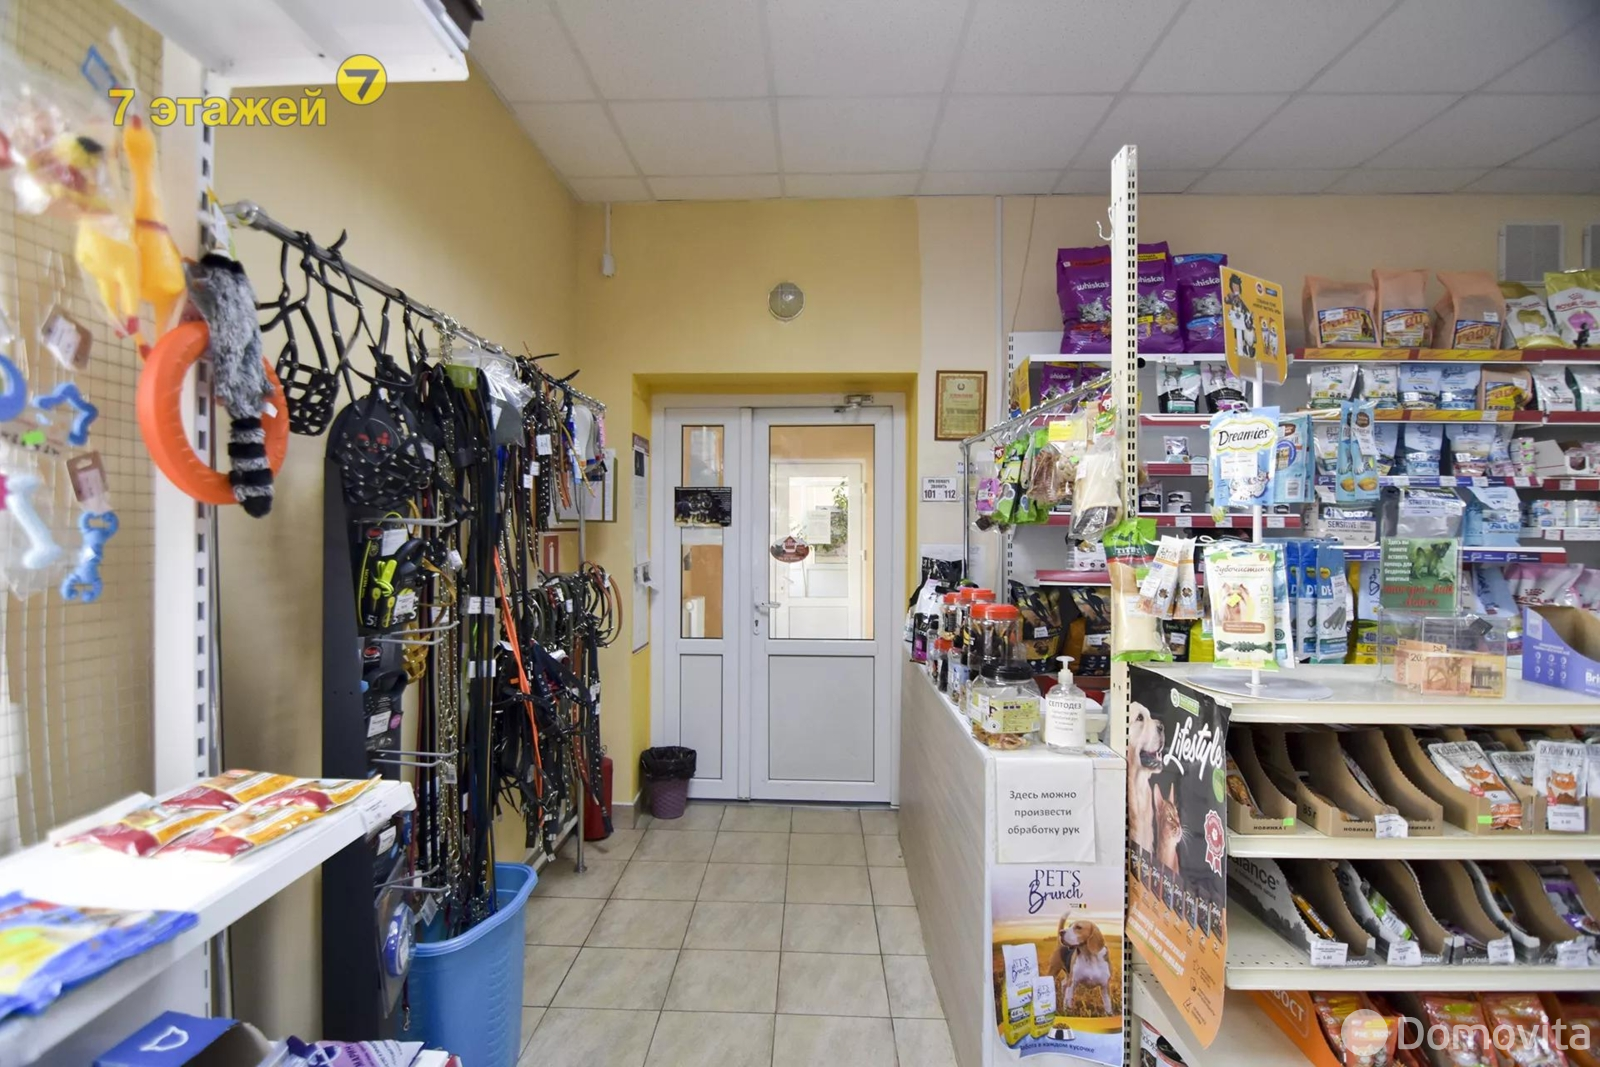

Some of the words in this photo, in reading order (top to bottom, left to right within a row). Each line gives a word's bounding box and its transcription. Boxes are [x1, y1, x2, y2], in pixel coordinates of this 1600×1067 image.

[1077, 281, 1110, 291] whiskas
[1193, 276, 1220, 287] whiska
[1218, 426, 1270, 447] Dreamies
[924, 489, 936, 499] 101
[944, 489, 956, 499] 112
[1327, 520, 1357, 529] SENSITIVE
[1585, 671, 1600, 683] Bri
[1048, 700, 1082, 710] СЕПТОДЕЗ
[1163, 716, 1223, 781] Lifestyle
[1009, 790, 1039, 801] Здесь
[1041, 790, 1077, 800] можно
[1014, 807, 1072, 819] произвести
[1302, 804, 1312, 817] 85
[1007, 824, 1060, 837] обработку
[1062, 826, 1080, 837] рук
[1035, 869, 1081, 887] PET'S
[1028, 879, 1083, 914] Brunch
[1462, 956, 1489, 964] probal
[1273, 990, 1304, 1022] ВОСТ
[1069, 1044, 1095, 1053] кусочке
